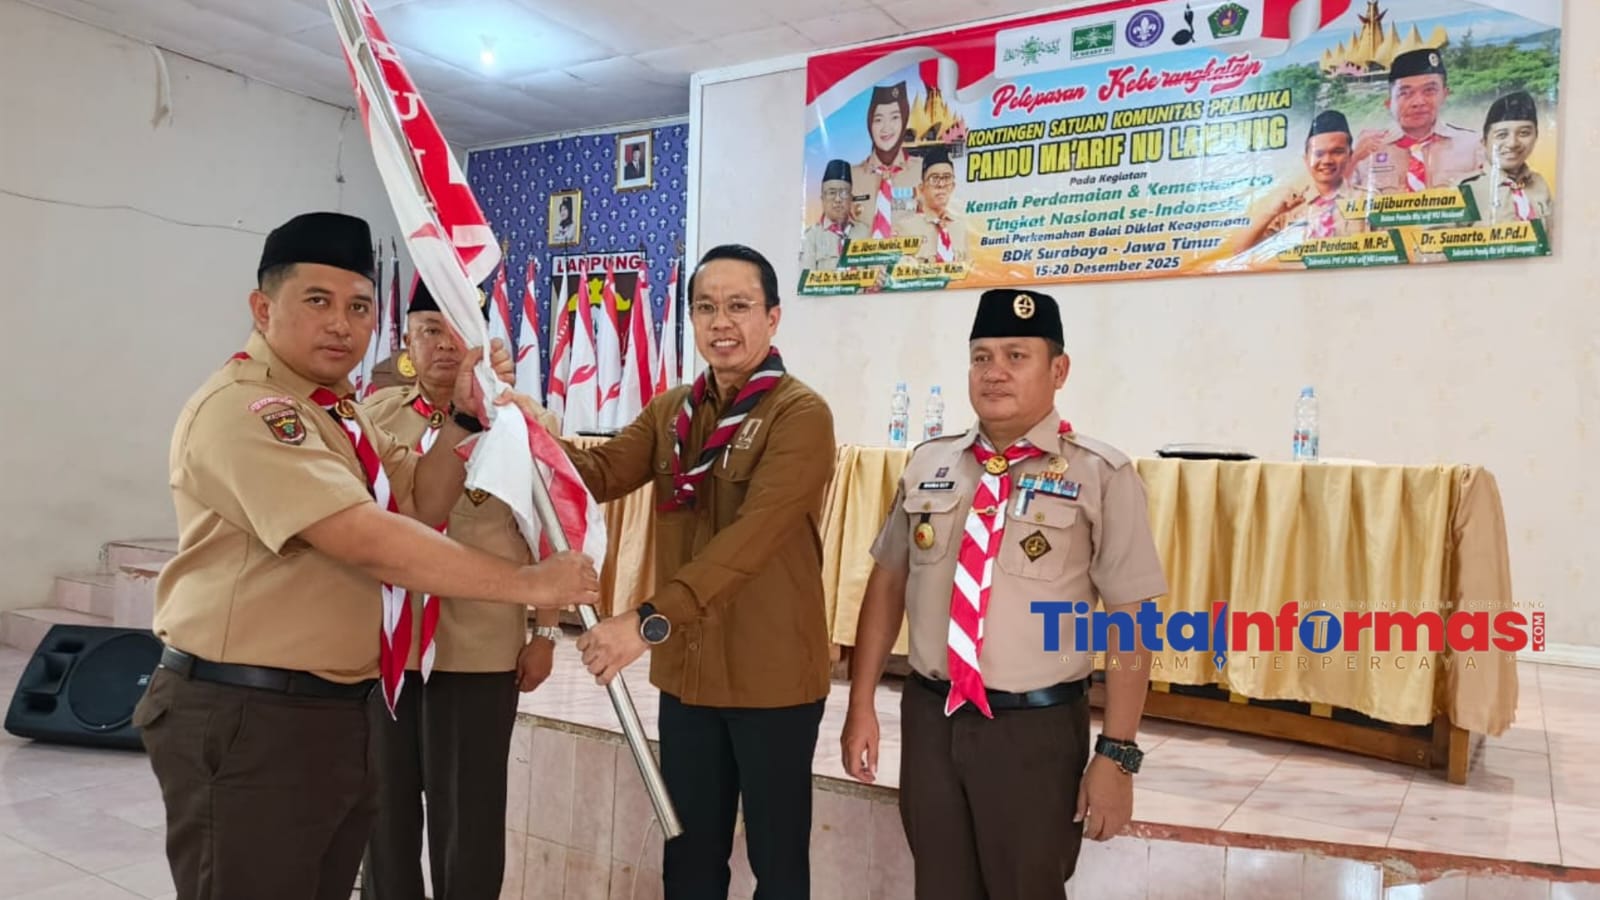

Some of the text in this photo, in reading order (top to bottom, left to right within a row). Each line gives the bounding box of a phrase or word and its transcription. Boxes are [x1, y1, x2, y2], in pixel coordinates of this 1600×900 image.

[992, 84, 1087, 117] Pelepasan
[967, 88, 1292, 148] KONTINGEN SATUAN KOMUNITAS PRAMUKA
[967, 115, 1288, 182] PANDU MA'ARIF NU LAMPUNG
[1070, 174, 1096, 186] Pada
[1099, 171, 1148, 185] Kegiatan
[966, 196, 1017, 213] Kemah
[1022, 188, 1122, 208] Perdamaian
[1128, 184, 1140, 198] &
[1345, 202, 1358, 212] H.
[981, 216, 1250, 246] Bumi Perkemahan Balai Diklat Keagamaan
[987, 217, 1045, 233] Tingkat
[1050, 206, 1125, 226] Nasional
[1363, 237, 1389, 249] M.Pd
[1421, 226, 1528, 245] Dr. Sunarto, M.Pd.I
[1002, 249, 1033, 261] BDK
[1037, 244, 1108, 260] Surabaya
[1123, 240, 1165, 254] Jawa
[1172, 236, 1221, 250] Timur
[557, 255, 643, 273] LAMPUNG
[1035, 256, 1180, 276] 15-20 Desember 2025
